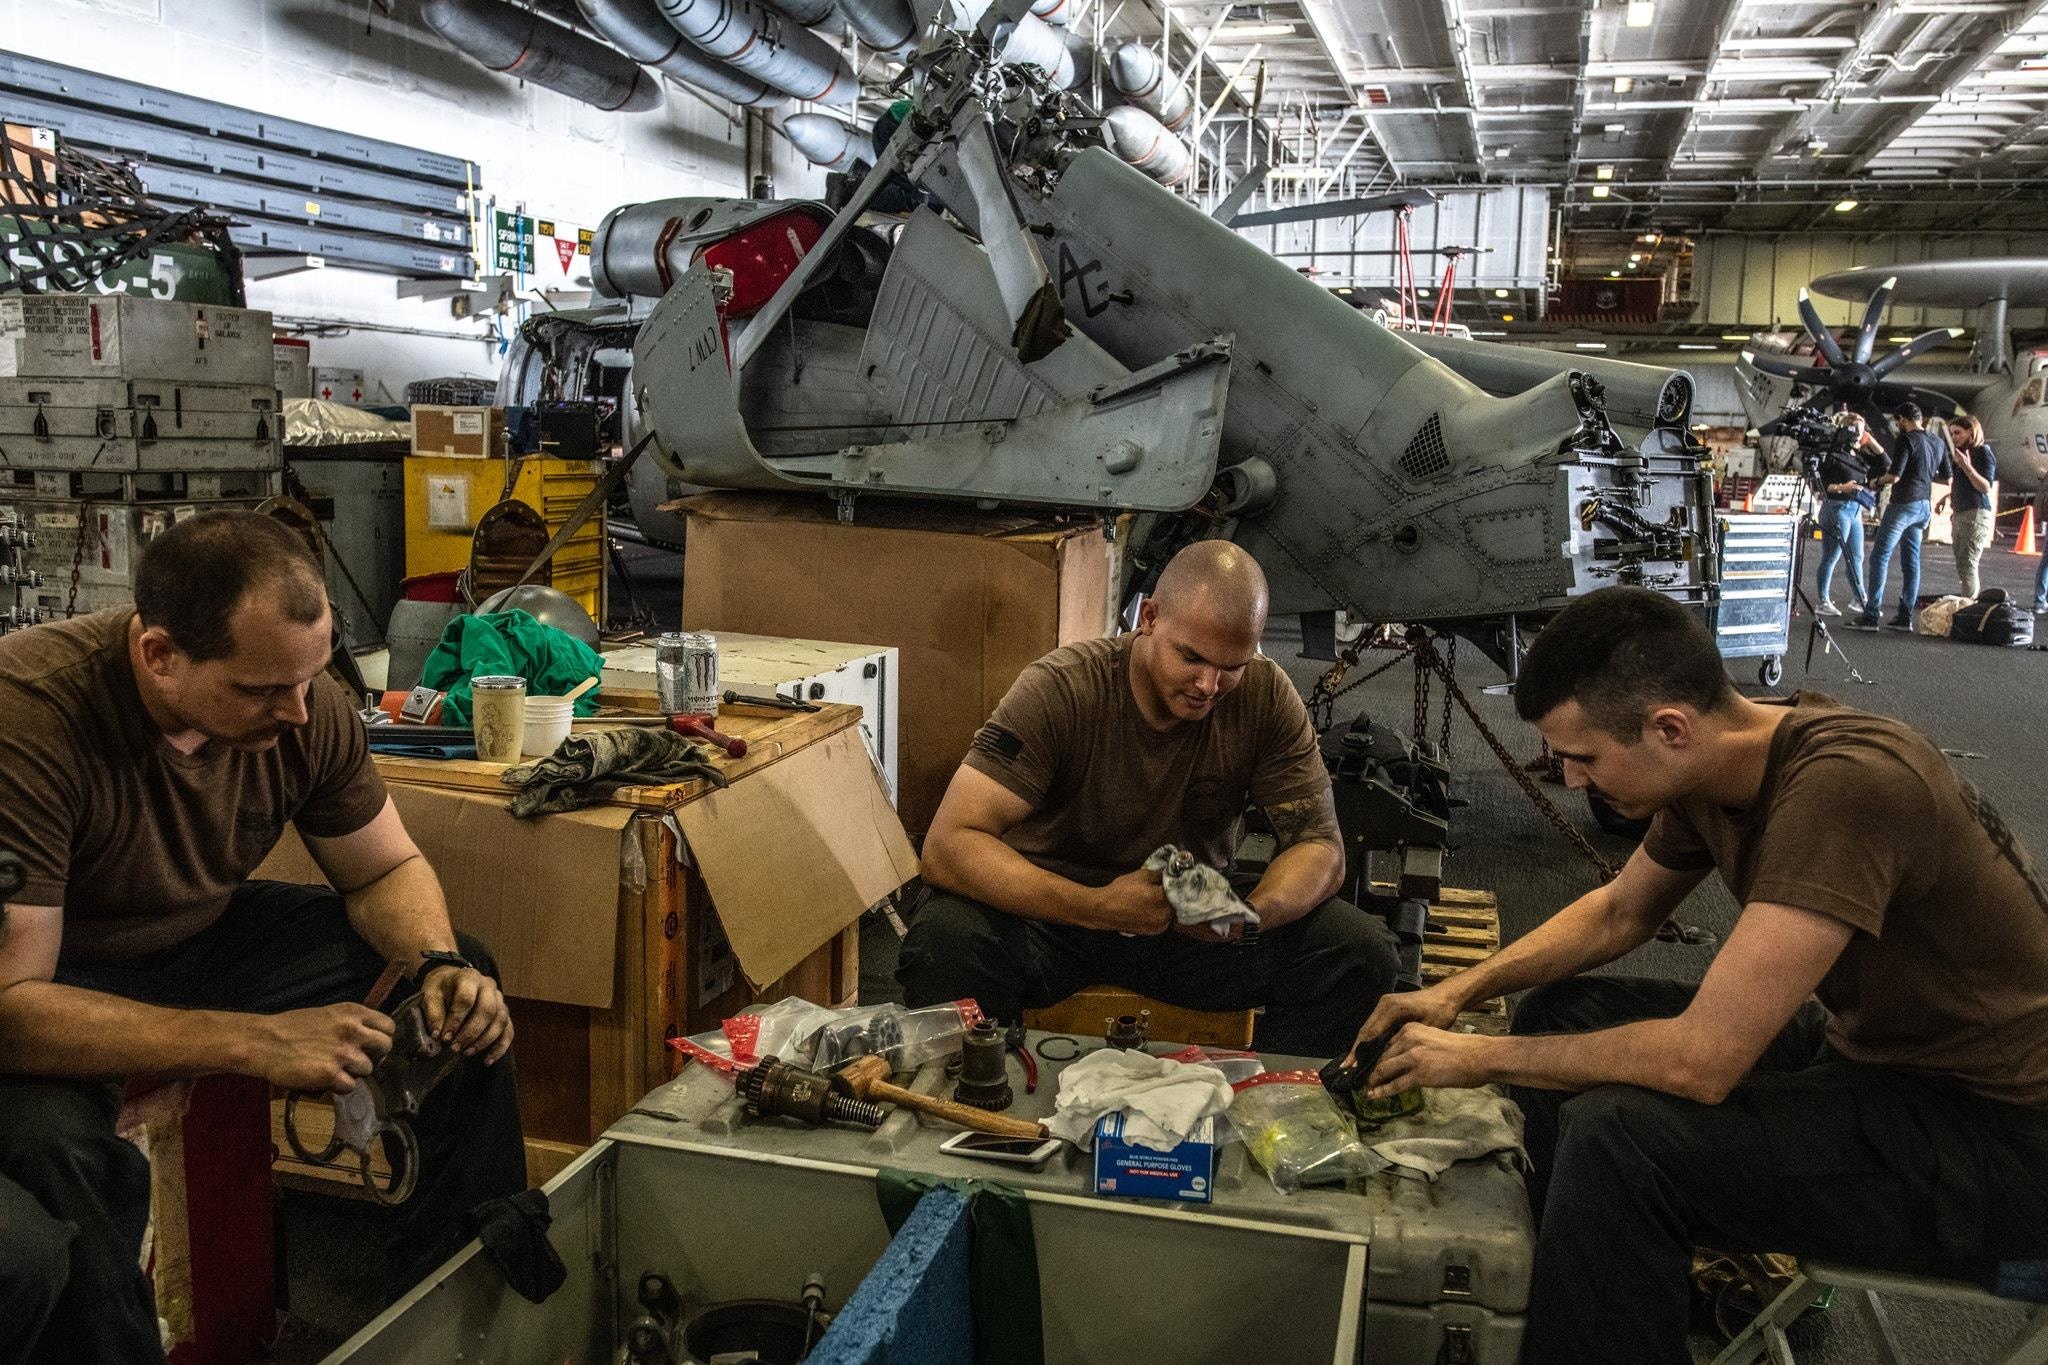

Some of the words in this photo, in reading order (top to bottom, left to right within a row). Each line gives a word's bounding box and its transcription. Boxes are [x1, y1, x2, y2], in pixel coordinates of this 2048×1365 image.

[53, 308, 86, 316] DESTROY
[1116, 1159, 1143, 1169] GENERAL
[1143, 1162, 1169, 1171] PURPOSE
[1169, 1164, 1193, 1173] GLOVES
